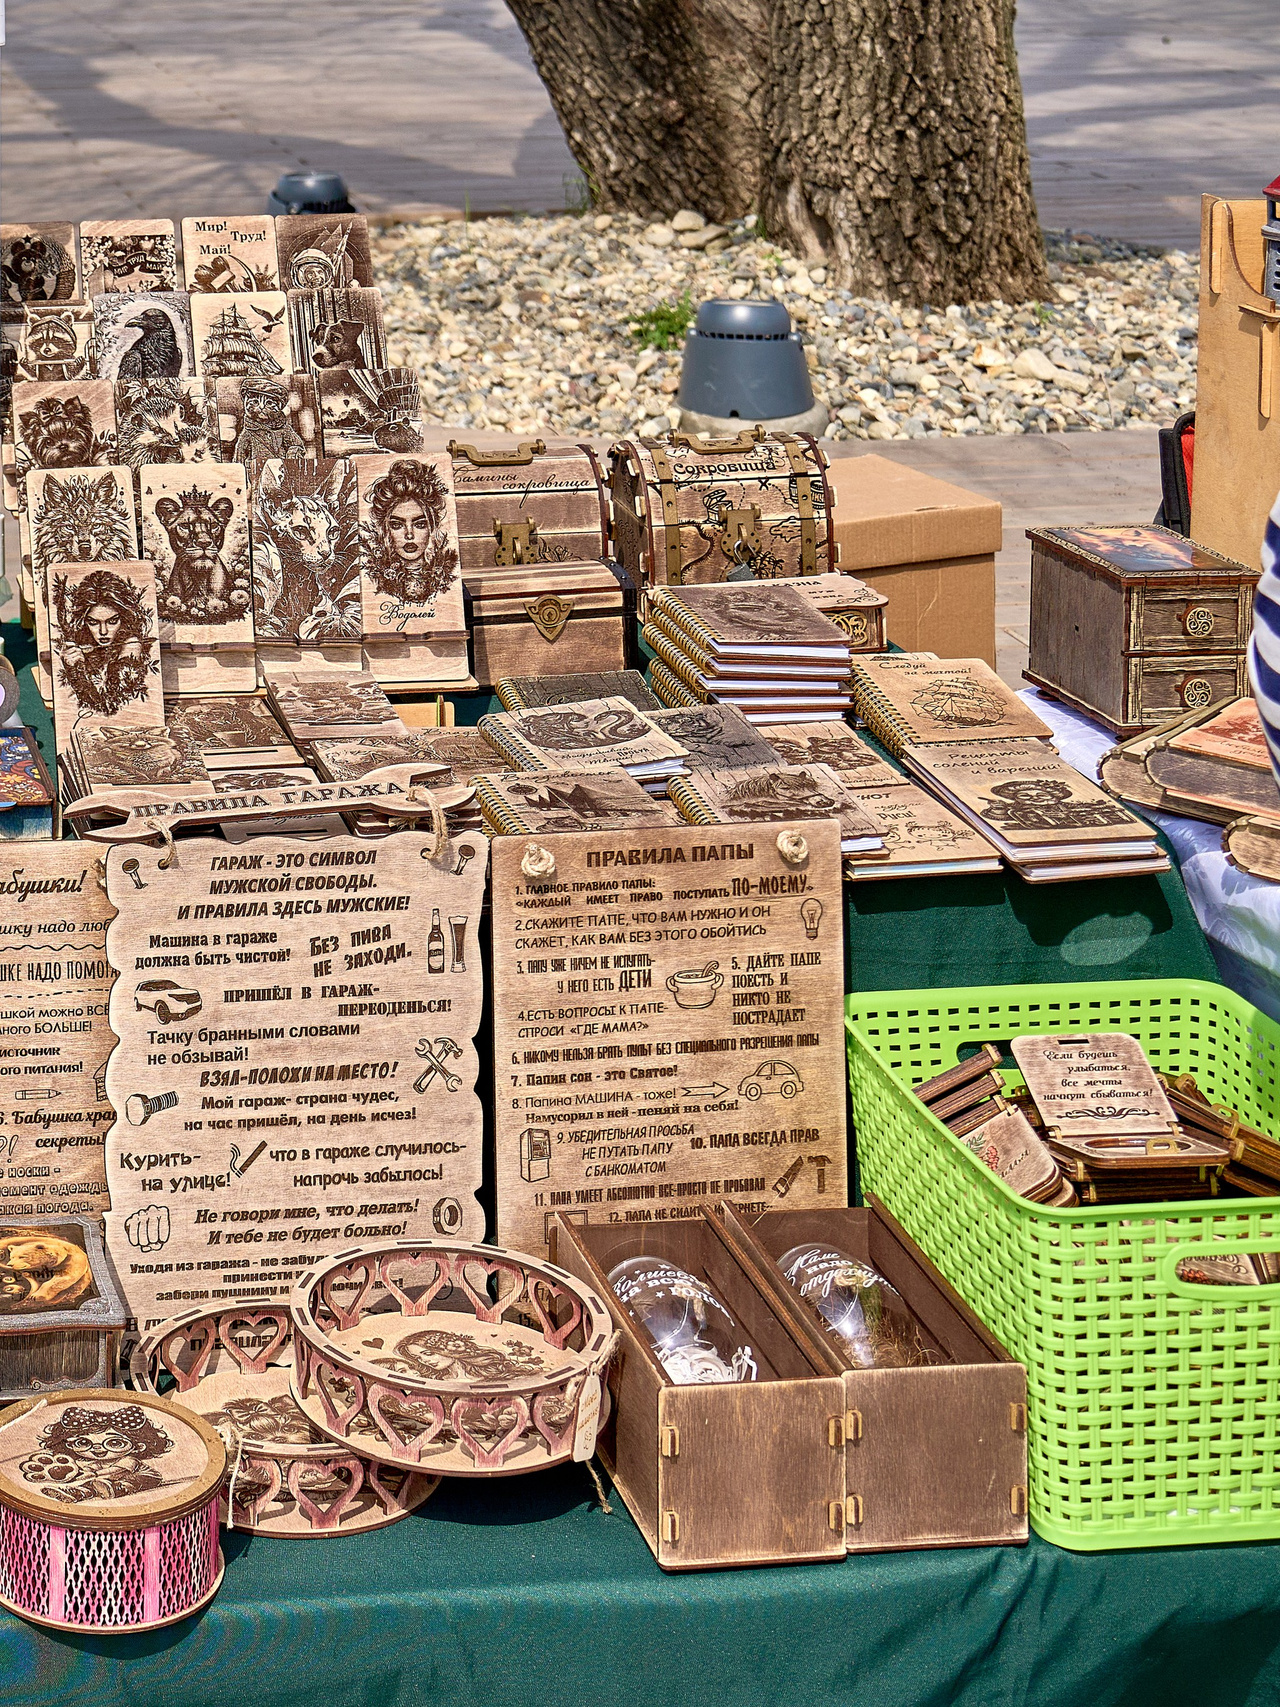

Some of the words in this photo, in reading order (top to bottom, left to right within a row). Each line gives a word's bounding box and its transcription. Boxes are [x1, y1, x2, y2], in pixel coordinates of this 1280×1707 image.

[196, 221, 227, 233] Мир!
[230, 230, 266, 243] Труд!
[199, 244, 232, 256] Май!
[674, 460, 777, 476] Сокровища
[502, 476, 591, 508] сокровища
[379, 601, 437, 632] Водолей
[879, 661, 928, 671] Следуй
[922, 667, 972, 676] мечтой!
[933, 759, 1001, 769] солений
[948, 750, 1030, 761] Рецепты
[983, 764, 1062, 774] варений!
[132, 793, 269, 818] ПРАВИЛА
[283, 781, 406, 806] ГАРАЖА
[210, 855, 262, 871] ГАРАЖ
[275, 853, 305, 868] ЭТО
[308, 850, 377, 866] СИМВОЛ
[586, 847, 686, 868] ПРАВИЛА
[691, 843, 754, 862] ПАПЫ
[209, 874, 291, 895] МУЖСКОЙ
[294, 873, 378, 892] СВОБОДЫ.
[515, 886, 523, 896] 1.
[525, 881, 569, 895] ГЛАВНОЕ
[572, 880, 619, 893] ПРАВИЛО
[621, 878, 656, 892] ПАПЫ:
[177, 904, 190, 920] И
[194, 900, 268, 919] ПРАВИЛА
[272, 900, 322, 918] ЗДЕСЬ
[326, 895, 411, 914] МУЖСКИЕ!
[149, 932, 209, 949] Машина
[213, 934, 221, 945] в
[225, 930, 278, 946] гараже
[310, 935, 340, 956] БЕЗ
[350, 923, 392, 947] ПИВА
[135, 953, 191, 970] должна
[194, 950, 231, 966] быть
[235, 948, 291, 963] чистой!
[313, 959, 333, 978] НЕ
[345, 942, 413, 973] ЗАХОДИ.
[731, 957, 741, 970] 5.
[745, 953, 785, 971] ДАЙТЕ
[790, 951, 821, 967] ПАПЕ
[731, 973, 774, 989] ПОЕСТЬ
[779, 972, 788, 986] И
[731, 993, 769, 1008] НИКТО
[776, 990, 791, 1005] НЕ
[38, 1007, 83, 1018] можно
[732, 1009, 806, 1026] ПОСТРАДАЕТ
[1043, 1049, 1073, 1061] Если
[1078, 1049, 1119, 1062] будешь
[1061, 1078, 1080, 1088] все
[1084, 1078, 1123, 1088] мечты
[1043, 1091, 1086, 1101] начнут
[1090, 1088, 1153, 1100] сбываться!
[690, 1137, 707, 1150] 10.
[710, 1133, 740, 1148] ПАПА
[743, 1130, 787, 1146] ВСЕГДА
[790, 1128, 820, 1143] ПРАВ
[120, 1152, 201, 1171] Курить-
[142, 1178, 163, 1192] на
[169, 1173, 231, 1193] улице!
